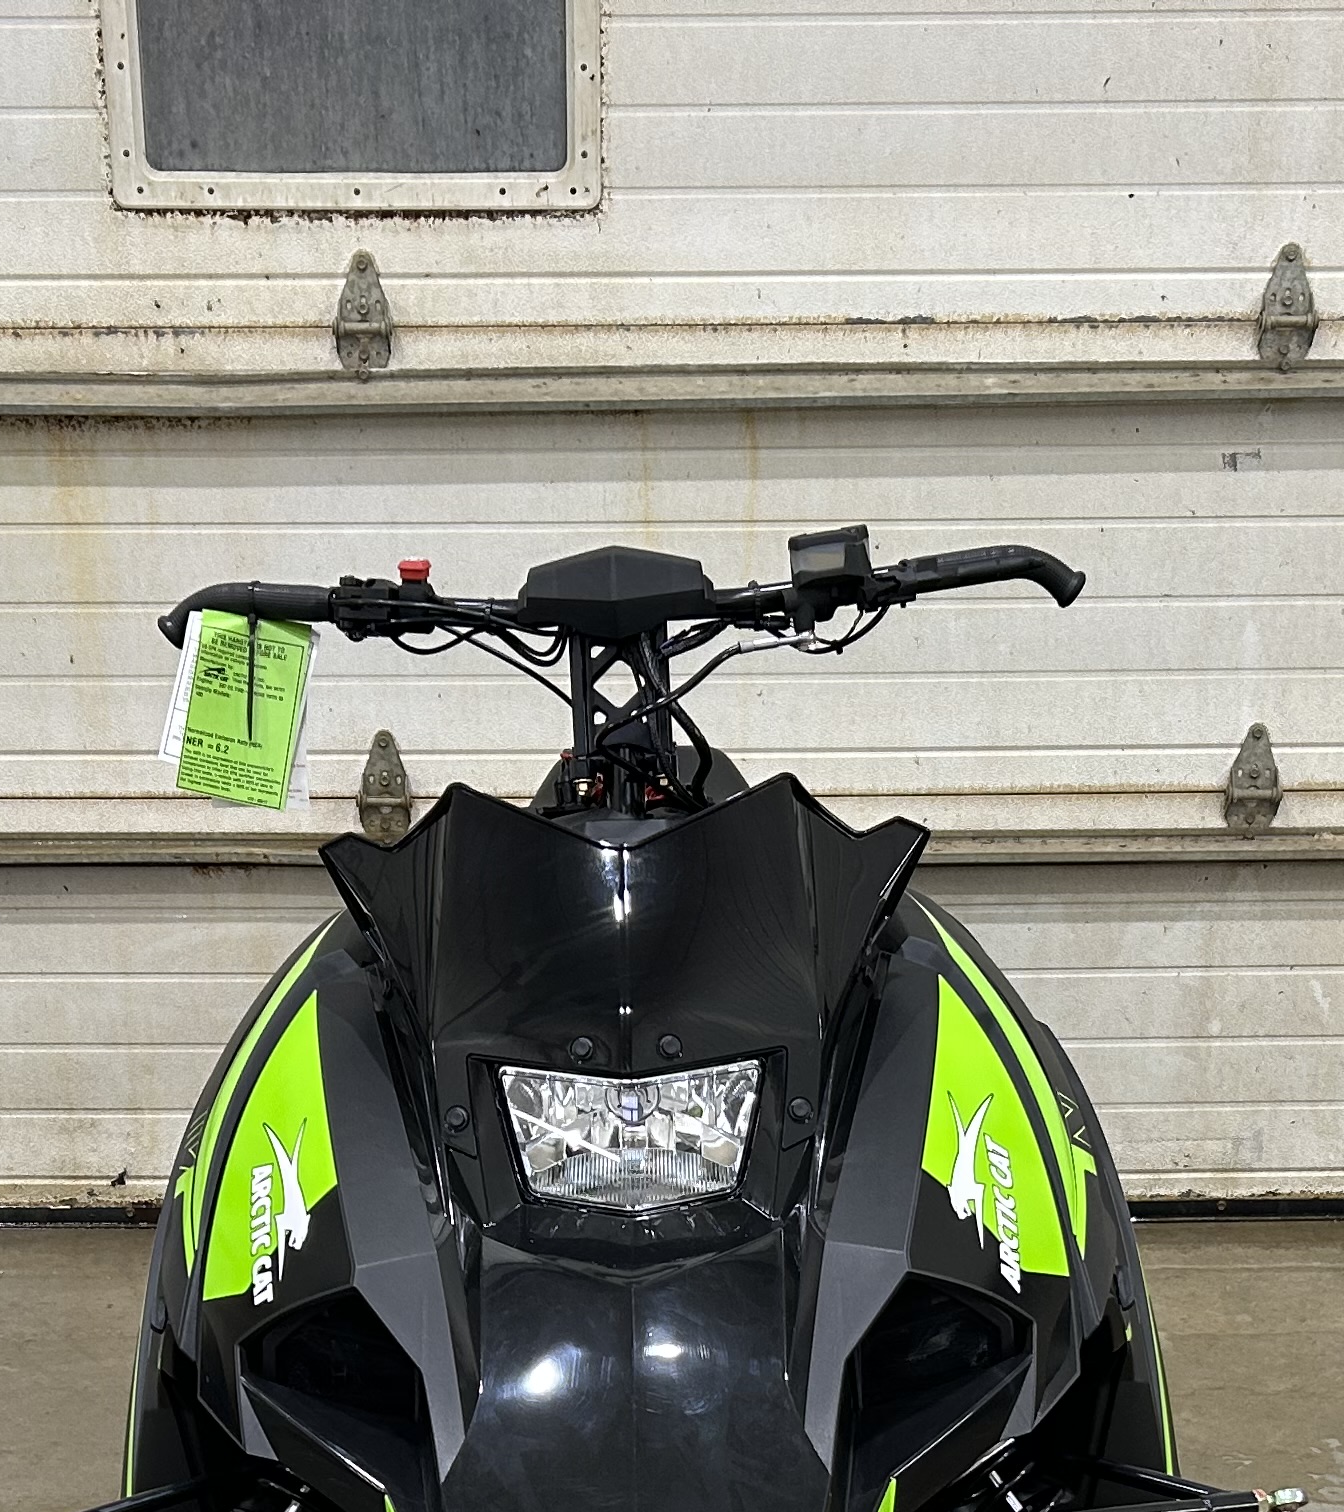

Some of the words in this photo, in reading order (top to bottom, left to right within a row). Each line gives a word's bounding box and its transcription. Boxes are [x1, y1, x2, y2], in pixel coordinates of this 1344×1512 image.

[185, 735, 204, 748] NER
[215, 742, 230, 755] 6.2
[983, 1133, 1014, 1190] CAT
[250, 1162, 274, 1256] ARCTIC
[993, 1186, 1022, 1295] ARCTIC
[252, 1253, 274, 1307] CAT
